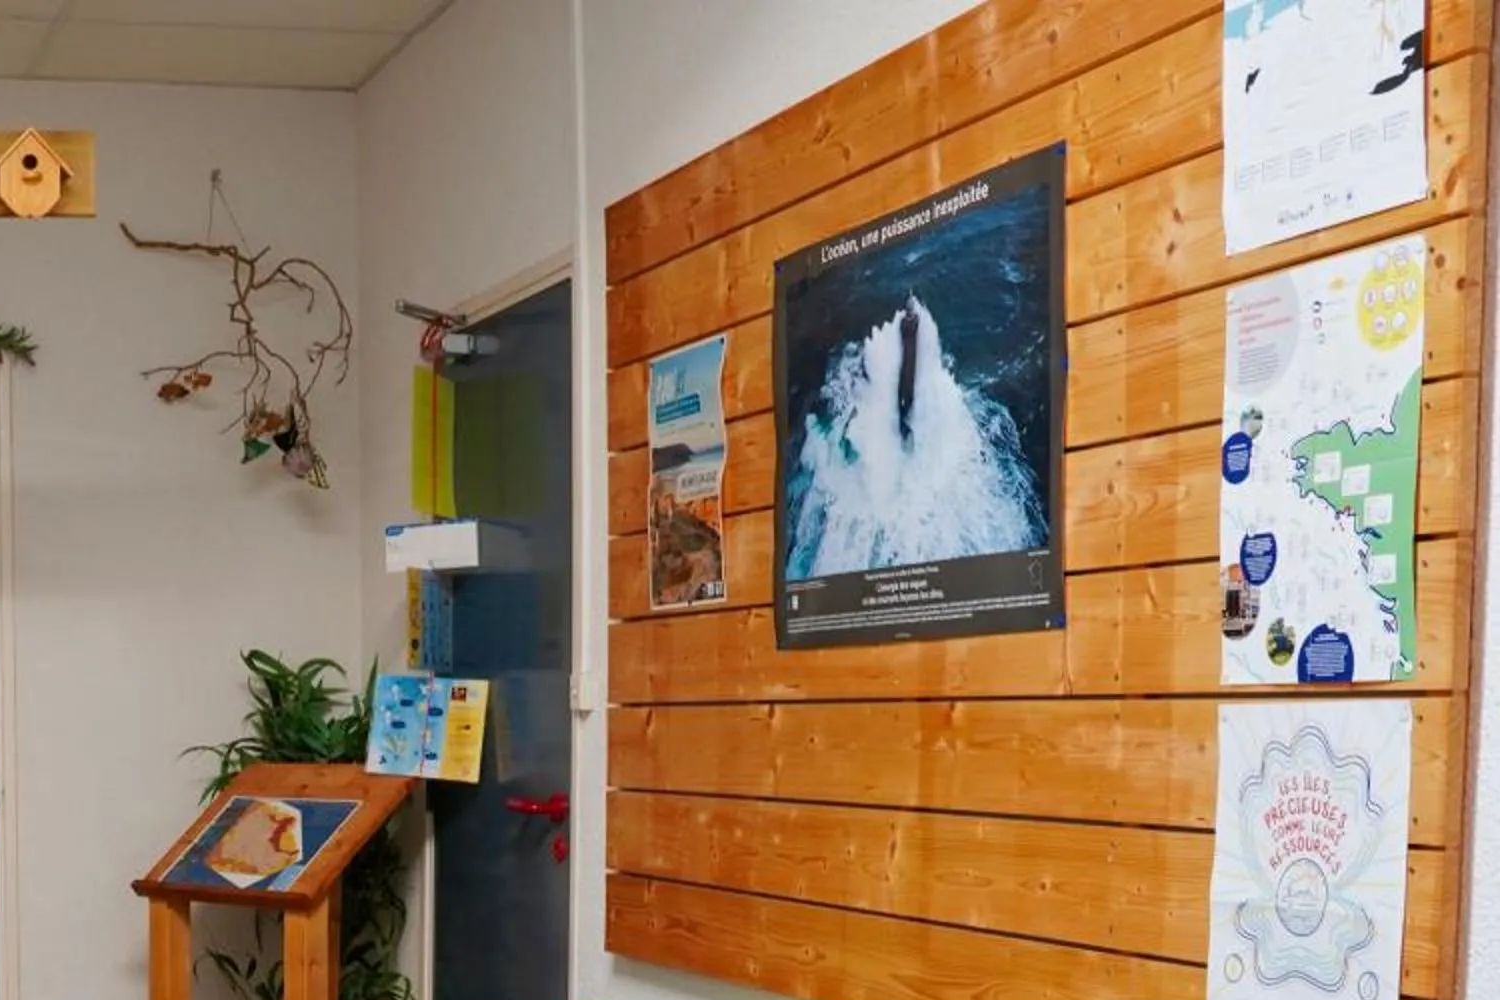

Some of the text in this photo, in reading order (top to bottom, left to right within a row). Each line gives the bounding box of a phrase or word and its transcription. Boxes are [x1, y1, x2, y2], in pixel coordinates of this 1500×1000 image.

[820, 180, 989, 265] L'océan, une puissance inexploitée
[1279, 776, 1298, 796] LES
[1271, 819, 1342, 846] COMME LEURS
[1269, 835, 1342, 875] RESSOURCES
